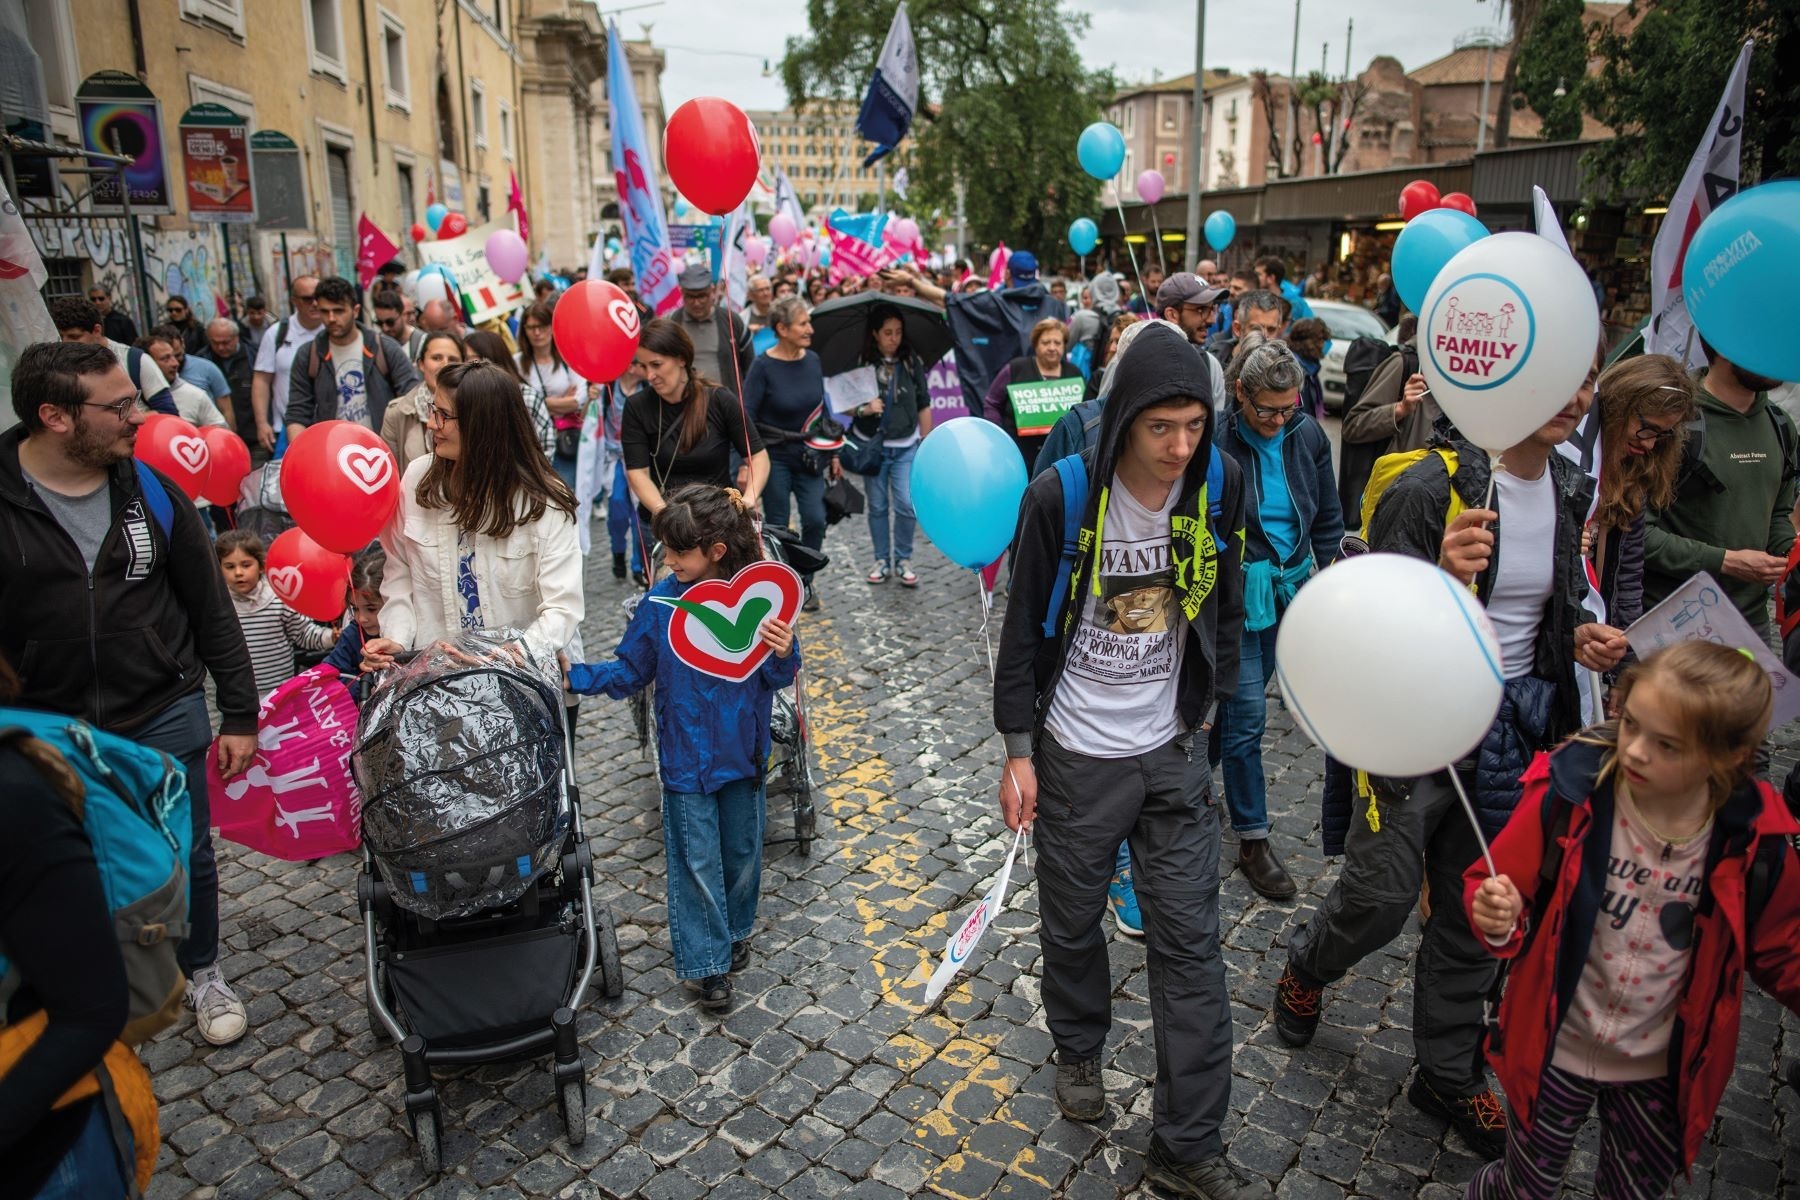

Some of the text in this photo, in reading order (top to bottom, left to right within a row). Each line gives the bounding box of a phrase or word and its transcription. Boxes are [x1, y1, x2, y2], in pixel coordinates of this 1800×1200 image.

[1435, 334, 1518, 360] FAMILY
[1449, 355, 1495, 377] DAY
[1012, 384, 1082, 400] NOI SIAMO
[1018, 404, 1041, 415] PER
[1042, 403, 1058, 413] LA
[127, 521, 153, 575] PUMA
[1089, 628, 1118, 643] DEAD
[1126, 636, 1140, 645] OR
[1088, 638, 1140, 661] RORONOA
[1139, 662, 1172, 678] MARINE
